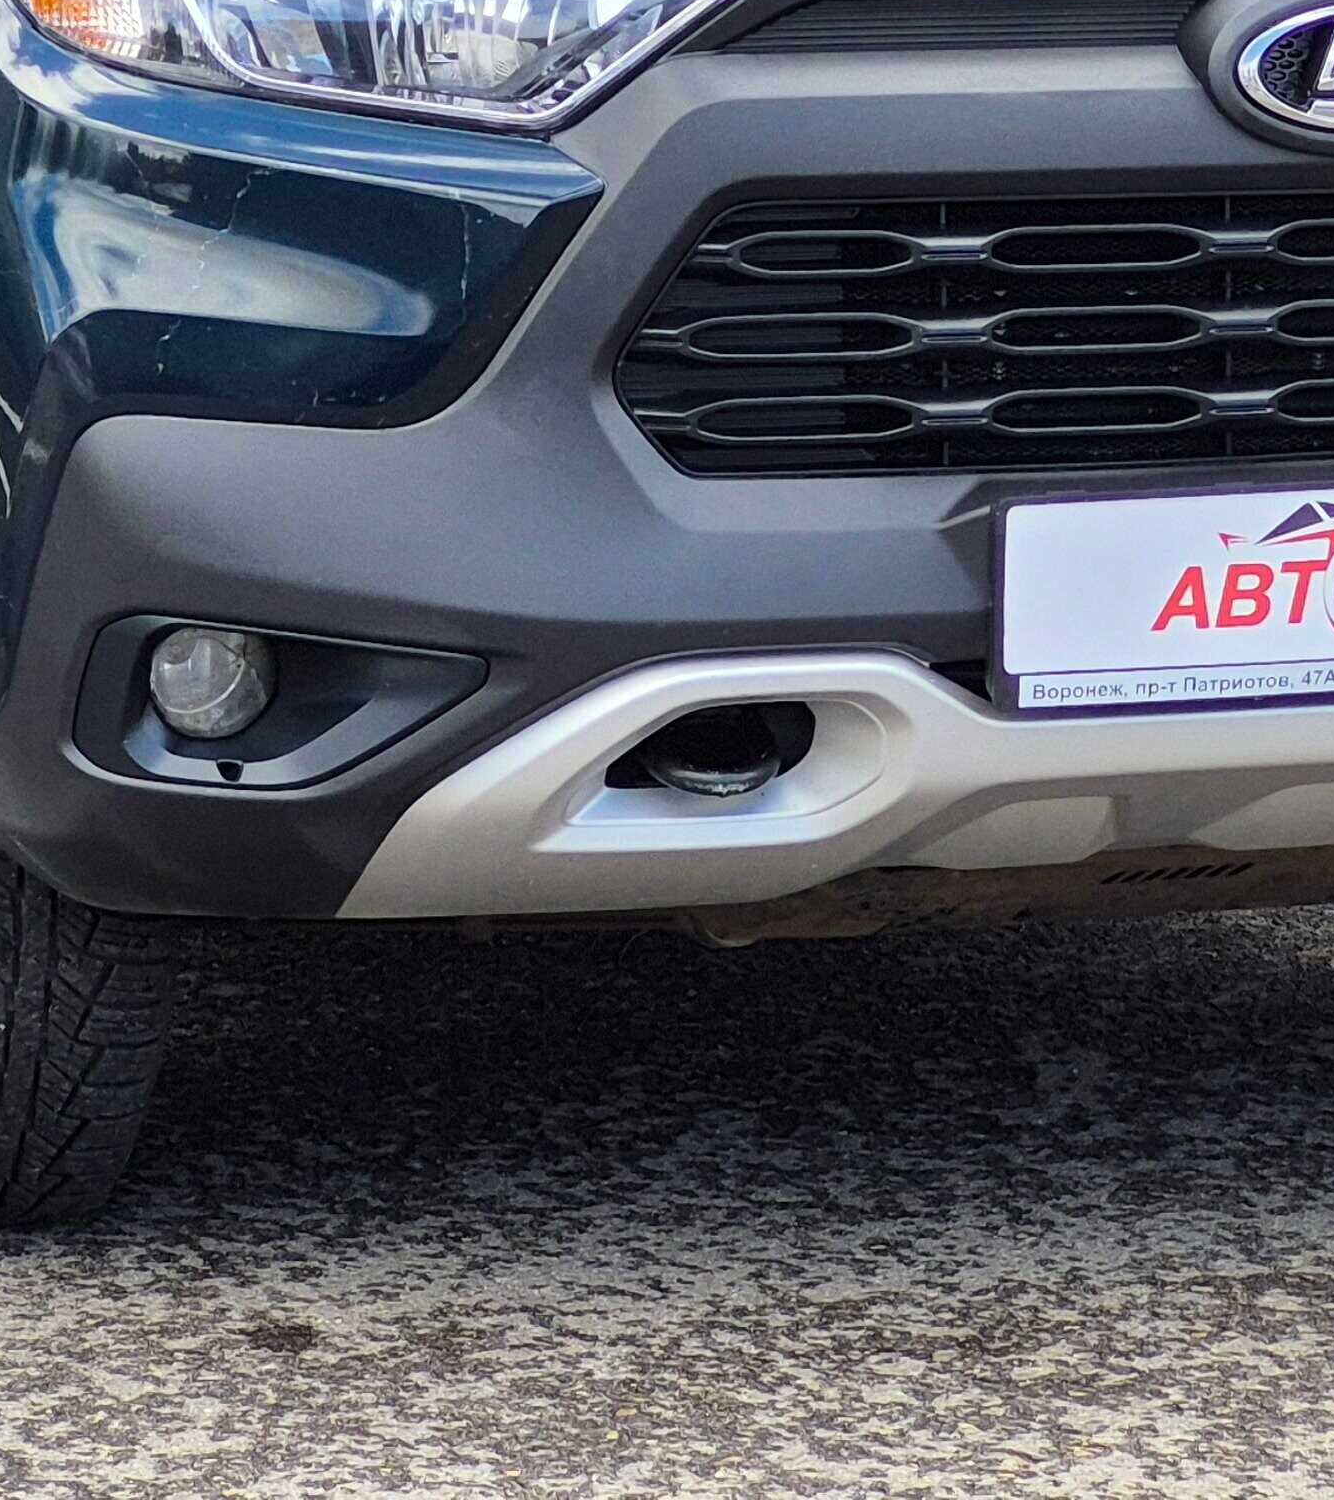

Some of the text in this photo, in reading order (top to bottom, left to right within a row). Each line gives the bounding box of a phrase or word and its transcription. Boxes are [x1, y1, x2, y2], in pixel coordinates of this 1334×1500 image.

[1032, 684, 1128, 702] Воронеж,
[1135, 680, 1177, 696] пр-т
[1183, 674, 1294, 694] Патриотов,
